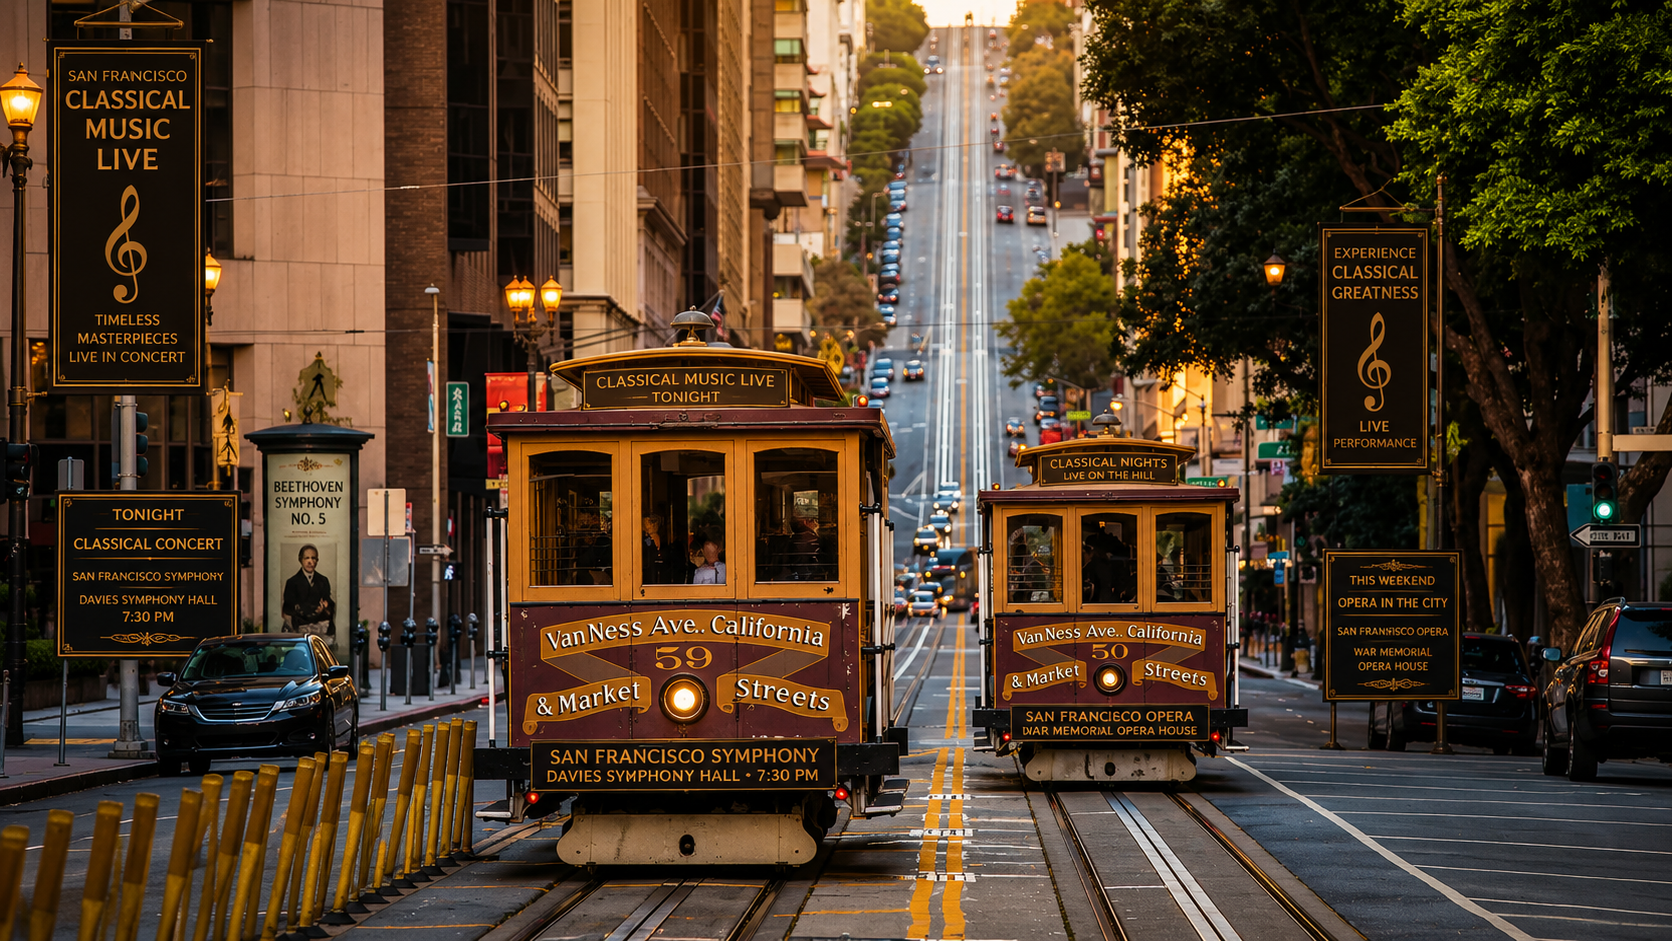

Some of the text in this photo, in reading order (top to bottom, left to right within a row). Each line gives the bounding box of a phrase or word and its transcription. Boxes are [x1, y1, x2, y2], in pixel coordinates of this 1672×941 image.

[68, 70, 187, 82] SAN FRANCISCO
[65, 90, 191, 110] CLASSICAL
[85, 118, 171, 140] MUSIC
[97, 148, 159, 171] LIVE
[1334, 247, 1416, 259] EXPERIENCE
[1332, 265, 1418, 280] CLASSICAL
[1332, 286, 1418, 300] GREATNESS
[95, 314, 160, 326] TIMELESS
[77, 333, 178, 345] MASTERPIECES
[69, 351, 186, 363] LIVE IN CONCERT
[596, 372, 776, 389] CLASSICAL MUSIC LIVE
[651, 390, 720, 403] TONIGHT
[1359, 420, 1390, 433] LIVE
[1333, 438, 1417, 449] PERFORMANCE
[1050, 457, 1168, 469] CLASSICAL NIGHTS
[1063, 471, 1155, 480] LIVE ON THE HILL
[274, 480, 344, 493] BEETHOVEN
[275, 496, 342, 509] SYMPHONY
[112, 508, 185, 521] TONIGHT
[291, 512, 326, 525] NO. 5
[73, 537, 224, 551] CLASSICAL CONCERT
[72, 571, 224, 582] SAN FRANCISCO SYMPHONY
[1349, 575, 1436, 586] THIS WEEKEND
[79, 594, 218, 605] DAVIES SYMPHONY HALL
[1337, 597, 1449, 609] OPERA IN THE CITY
[122, 610, 174, 623] 7:30 PM
[546, 629, 585, 651] Van
[588, 620, 643, 643] Ness
[711, 614, 825, 648] California
[1017, 631, 1043, 646] Van
[1045, 626, 1081, 641] Ness
[1127, 624, 1203, 647] California
[1337, 626, 1357, 636] SAN
[1416, 626, 1449, 637] OPERA
[1091, 643, 1129, 660] 50
[1353, 647, 1433, 657] WAR MEMORIAL
[655, 646, 713, 671] 59
[1357, 661, 1429, 671] OPERA HOUSE
[1012, 663, 1080, 689] & Market
[1144, 661, 1207, 687] Streets
[537, 680, 641, 716] & Market
[735, 677, 831, 712] Streets
[1025, 710, 1055, 722] SAN
[1145, 710, 1194, 722] OPERA
[1116, 725, 1156, 736] OPERA
[1158, 725, 1198, 736] HOUSE
[550, 747, 820, 765] SAN FRANCISCO SYMPHONY
[546, 769, 819, 783] DAVIES SYMPHONY HALL 7:30 PM
